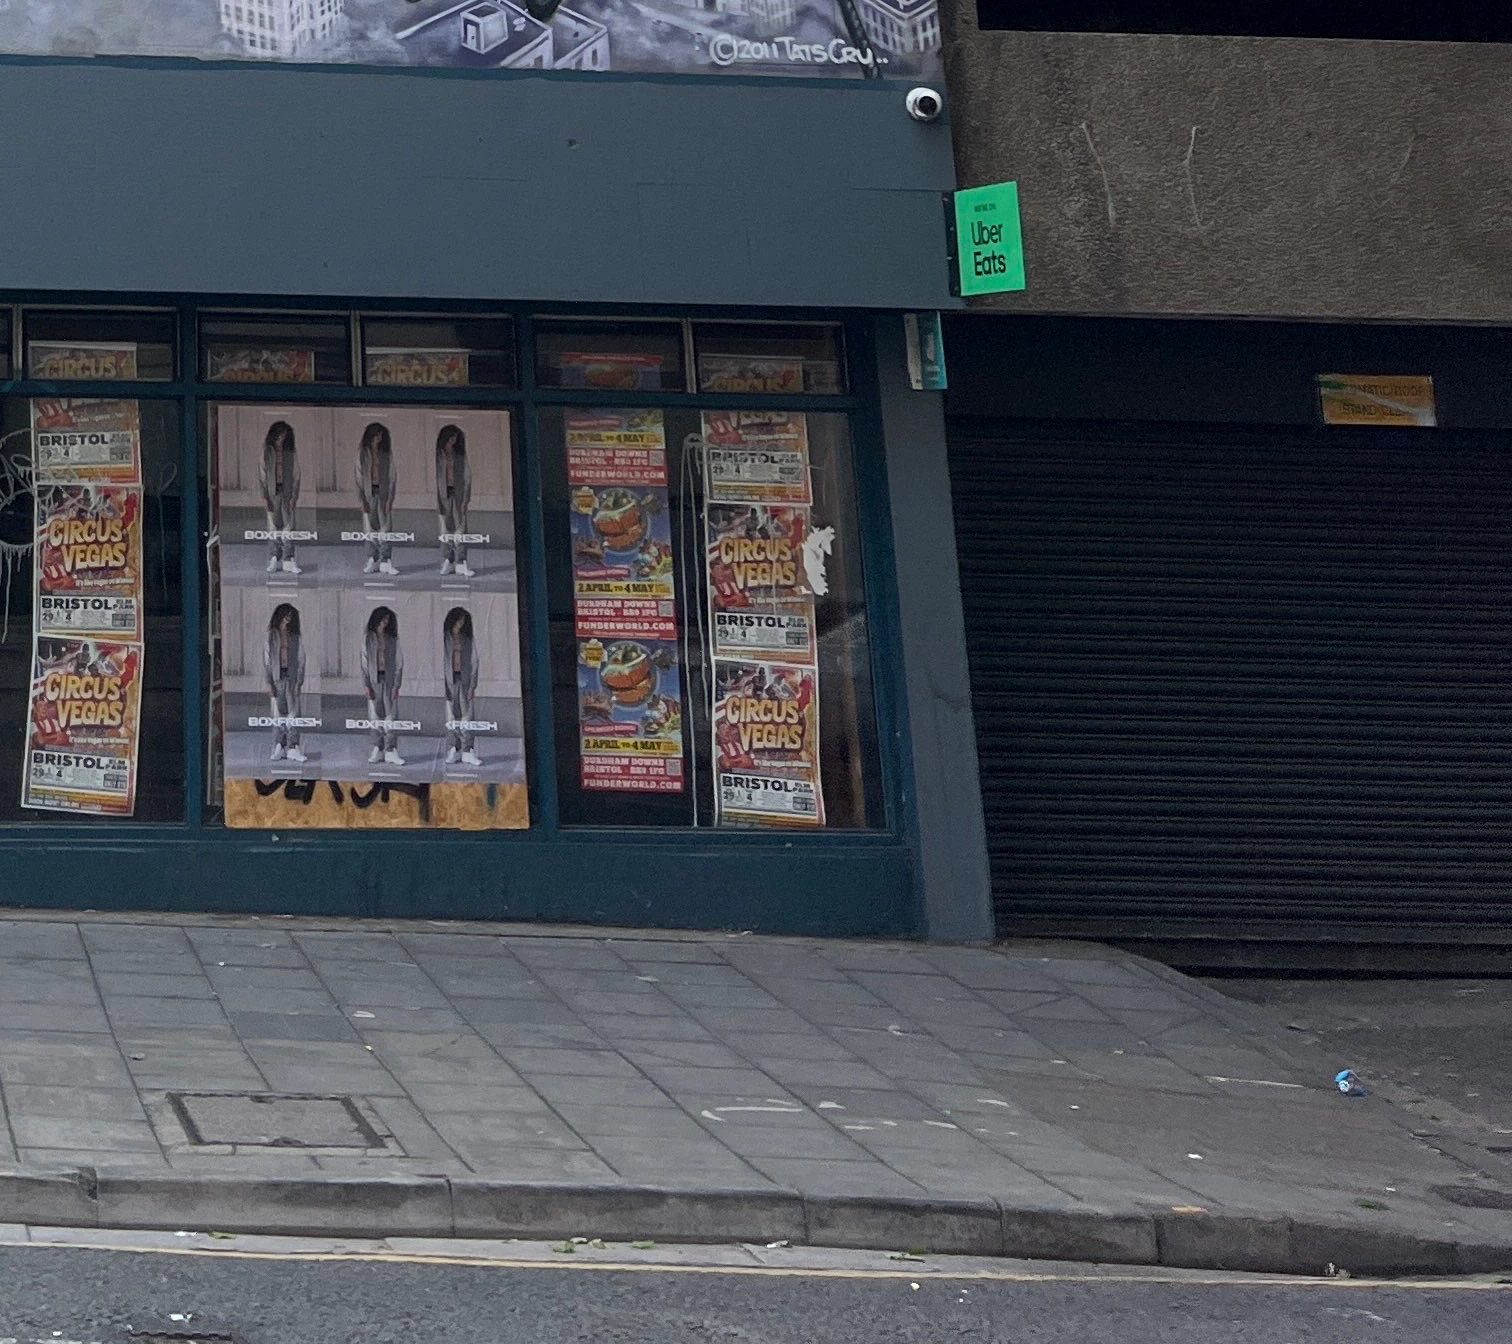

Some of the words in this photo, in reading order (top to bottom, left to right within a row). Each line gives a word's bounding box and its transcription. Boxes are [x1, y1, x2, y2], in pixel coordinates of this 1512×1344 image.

[971, 221, 1003, 246] Uber
[973, 250, 1006, 276] Eats
[43, 357, 118, 379] CIRCUS
[376, 365, 449, 385] CIRCUS
[40, 434, 109, 447] BRISTOL
[49, 519, 123, 548] CIRCUS
[244, 530, 318, 541] BOXFRESH
[340, 531, 415, 542] BOXFRESH
[61, 542, 127, 570] VEGAS
[720, 537, 792, 563] CIRCUS
[733, 562, 797, 589] VEGAS
[585, 583, 611, 593] APRIL
[633, 584, 655, 593] MAY
[42, 597, 113, 611] BRISTOL
[578, 622, 674, 631] FUNDERWORLD.COM
[717, 614, 786, 627] BRISTOL
[45, 672, 122, 701] CIRCUS
[56, 699, 125, 727] VEGAS
[726, 697, 799, 724] CIRCUS
[248, 717, 322, 727] BOXFRESH
[345, 719, 421, 731] BOXFRESH
[592, 740, 619, 749] APRIL
[641, 741, 663, 750] MAY
[738, 723, 804, 751] VEGAS
[33, 752, 105, 770] BRISTOL
[722, 776, 794, 793] BRISTOL
